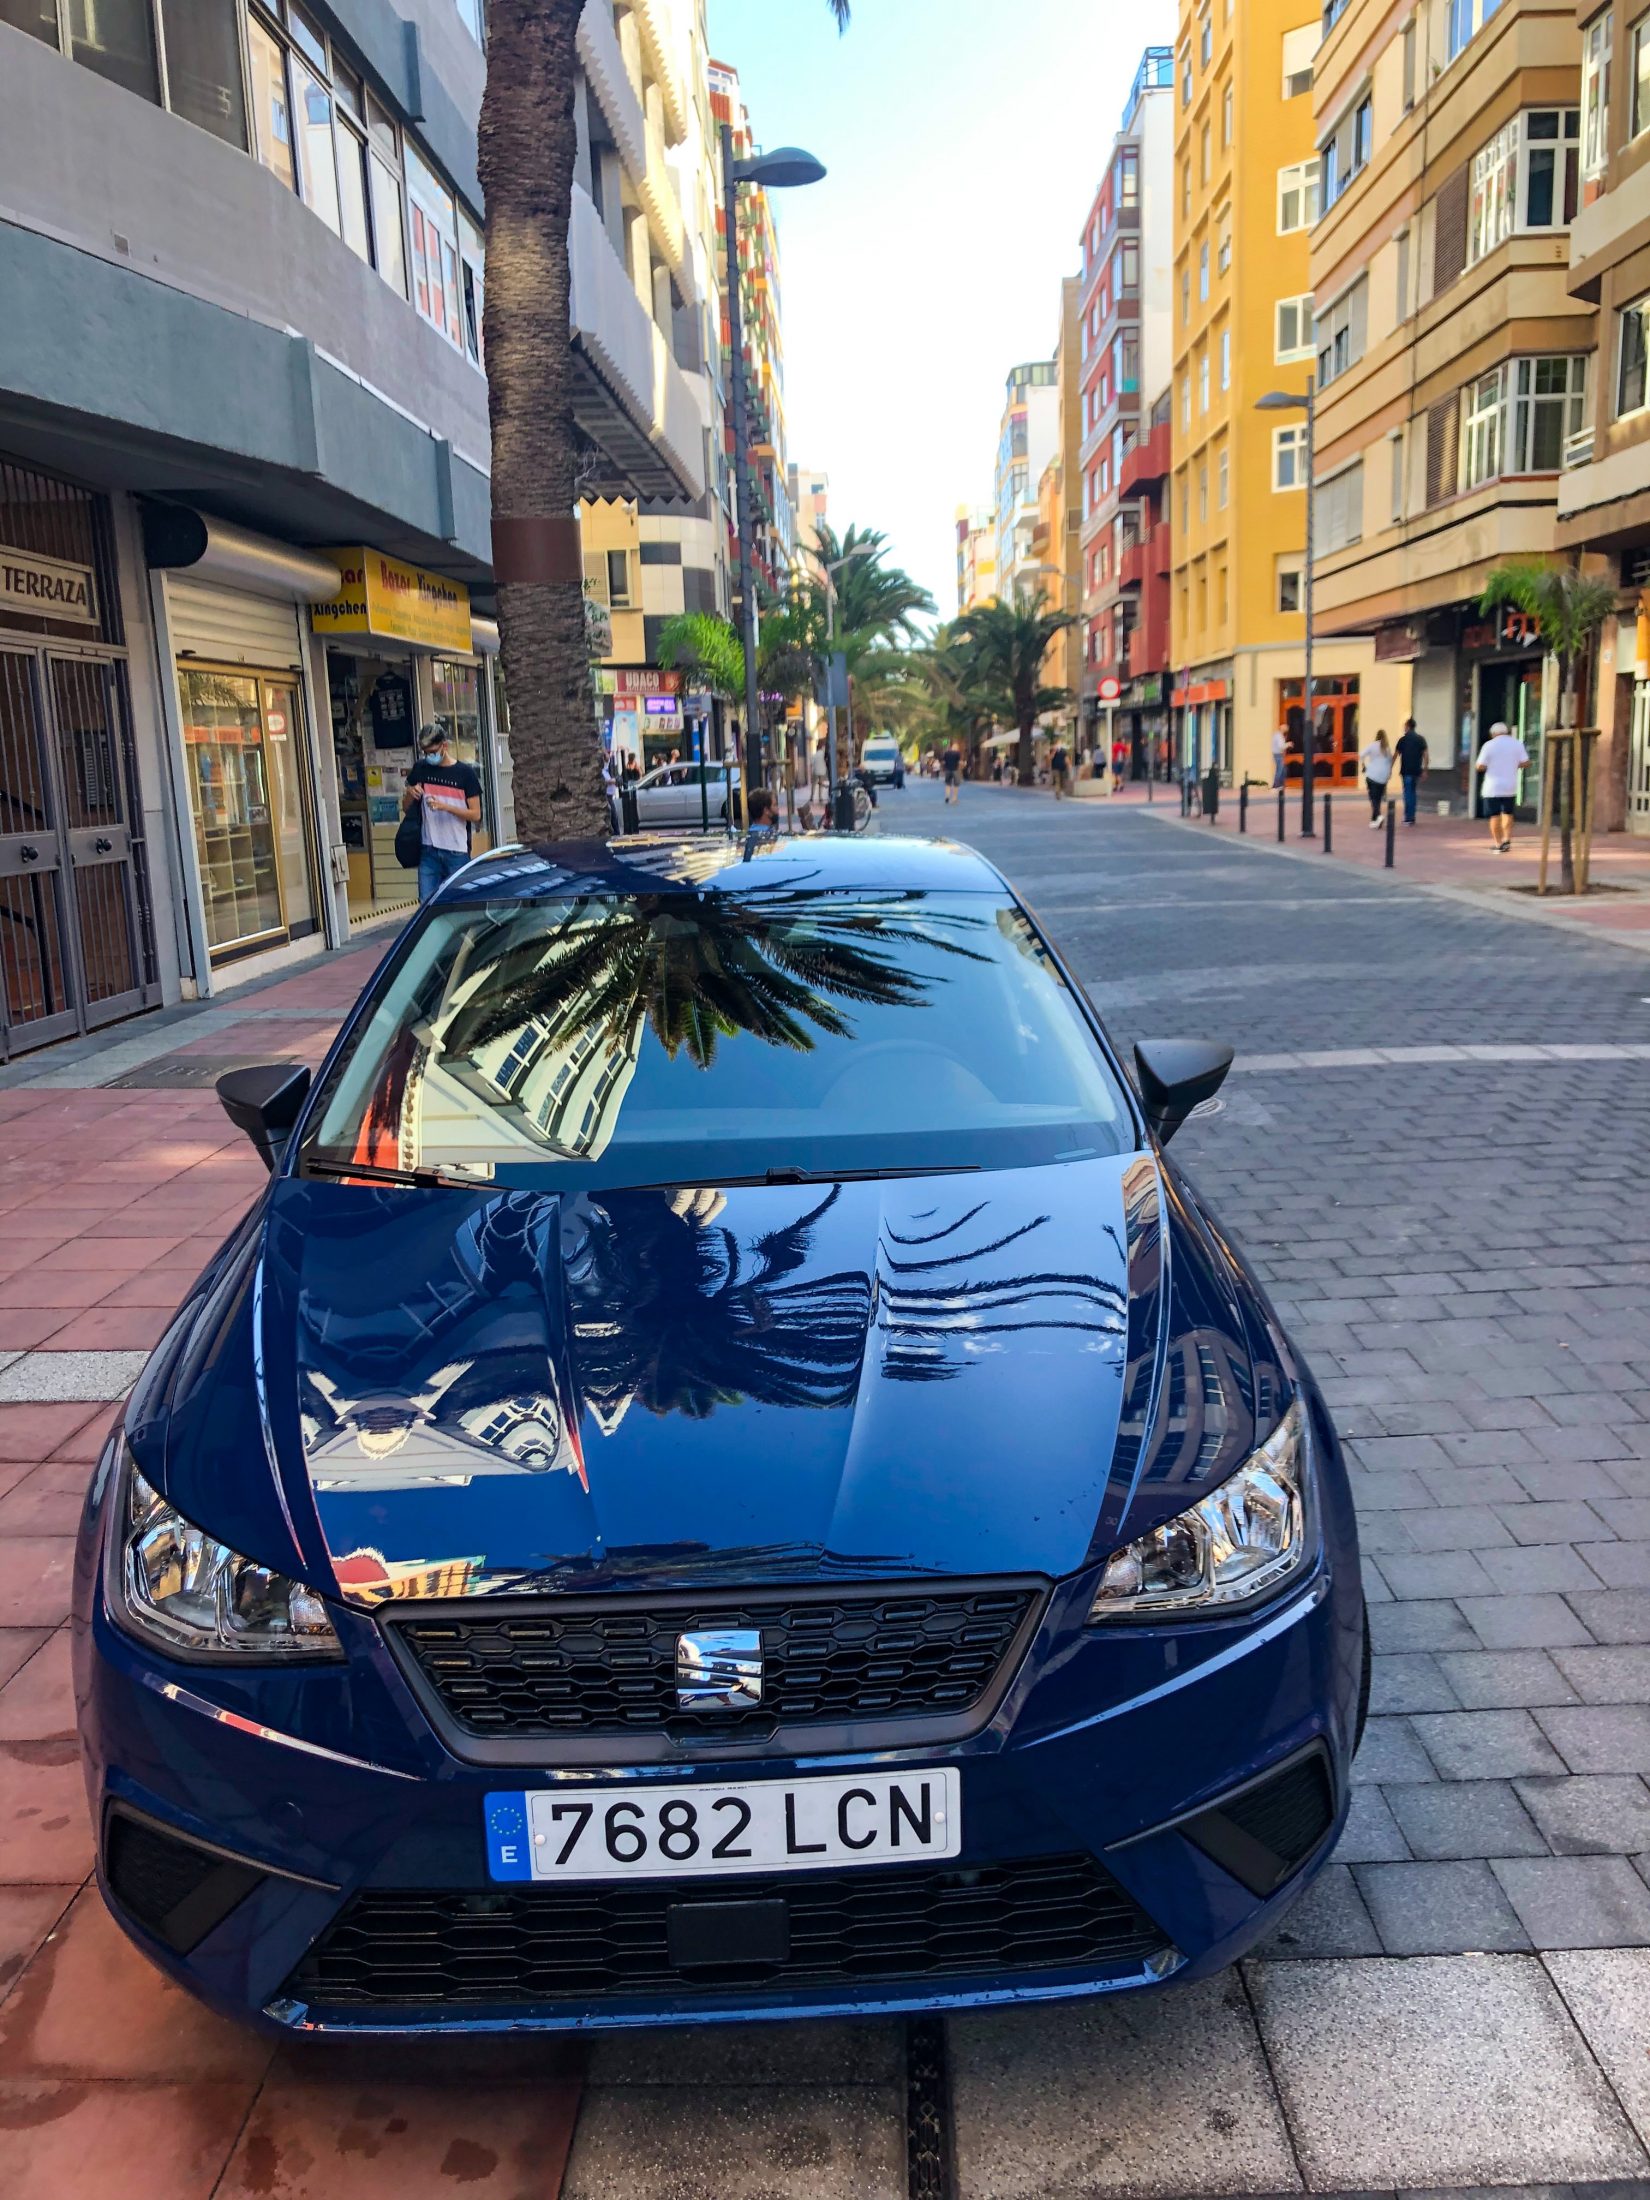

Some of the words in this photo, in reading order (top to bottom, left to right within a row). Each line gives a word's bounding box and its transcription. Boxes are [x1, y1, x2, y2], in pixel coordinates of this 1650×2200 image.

[1, 565, 87, 606] TERRAZA
[551, 1796, 752, 1865] 7682
[784, 1783, 932, 1855] LCN
[501, 1845, 518, 1863] E
